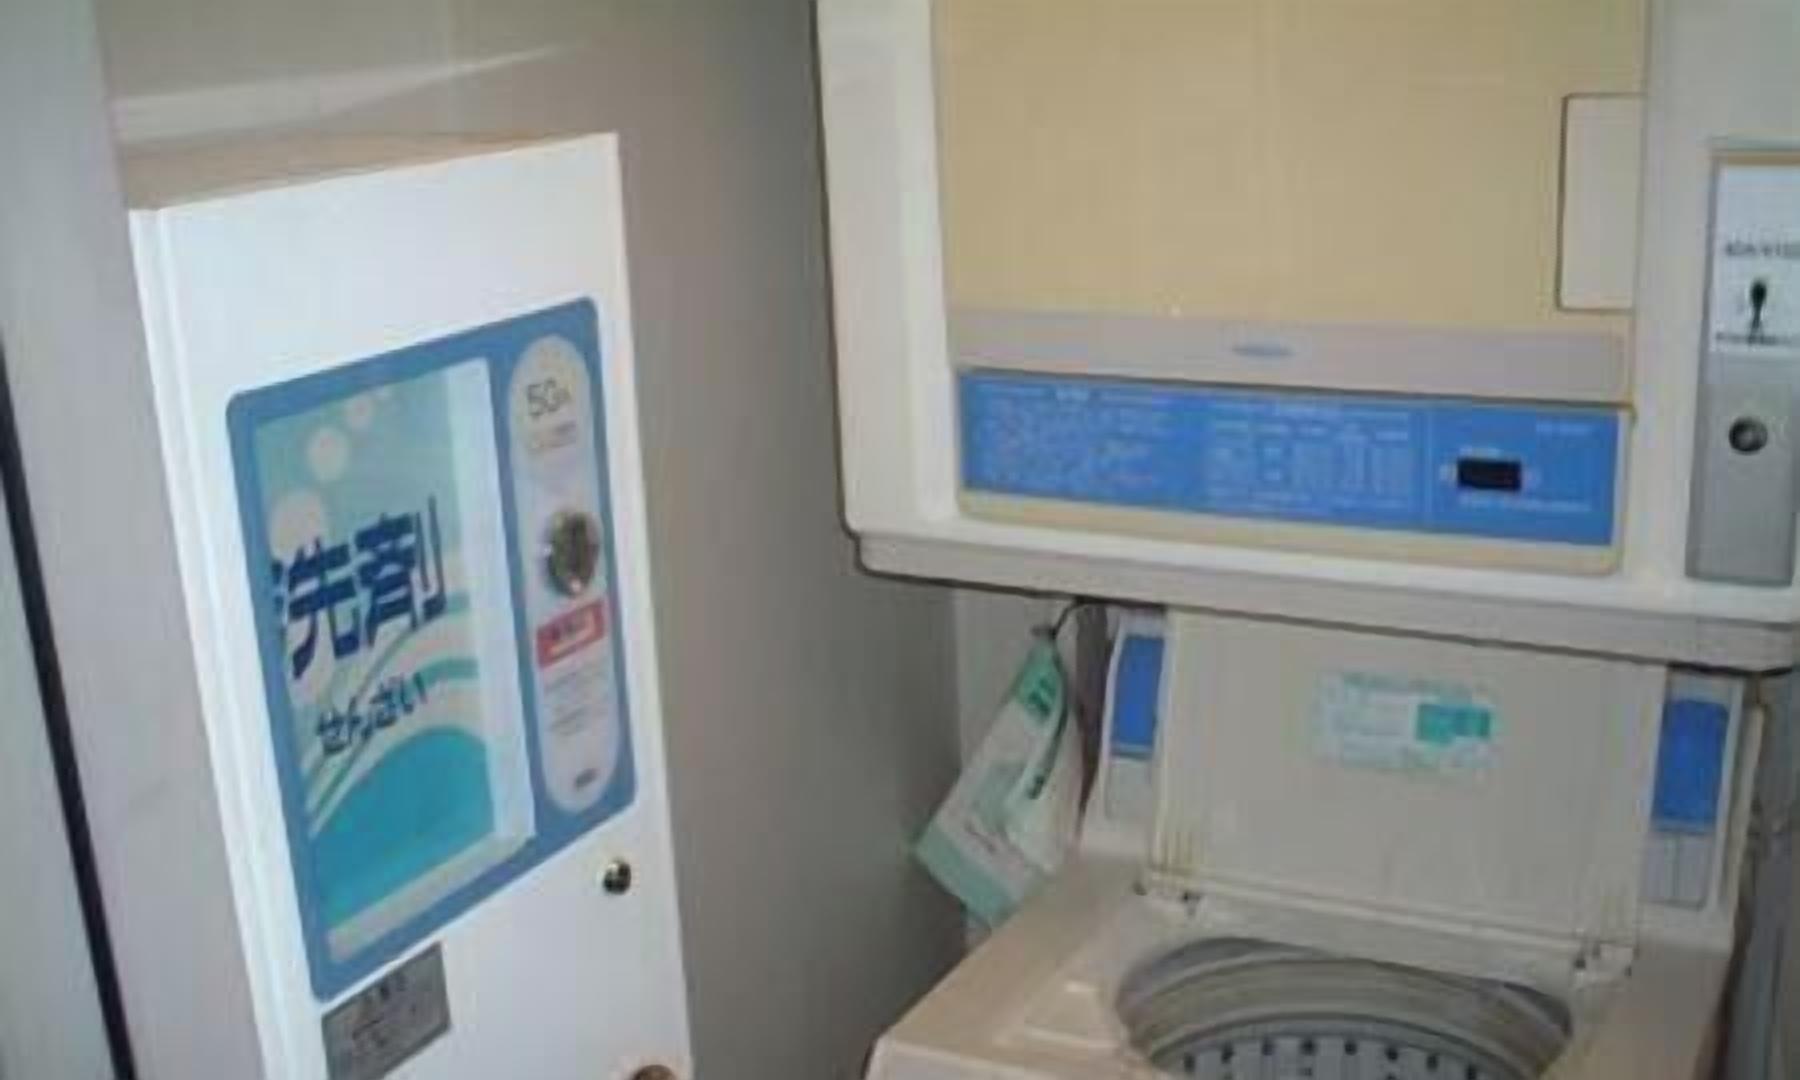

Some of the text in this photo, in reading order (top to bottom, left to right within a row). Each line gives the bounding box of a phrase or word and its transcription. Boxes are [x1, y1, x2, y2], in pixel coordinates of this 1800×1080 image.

[271, 495, 446, 678] 洗剤
[315, 671, 428, 755] せんざい
